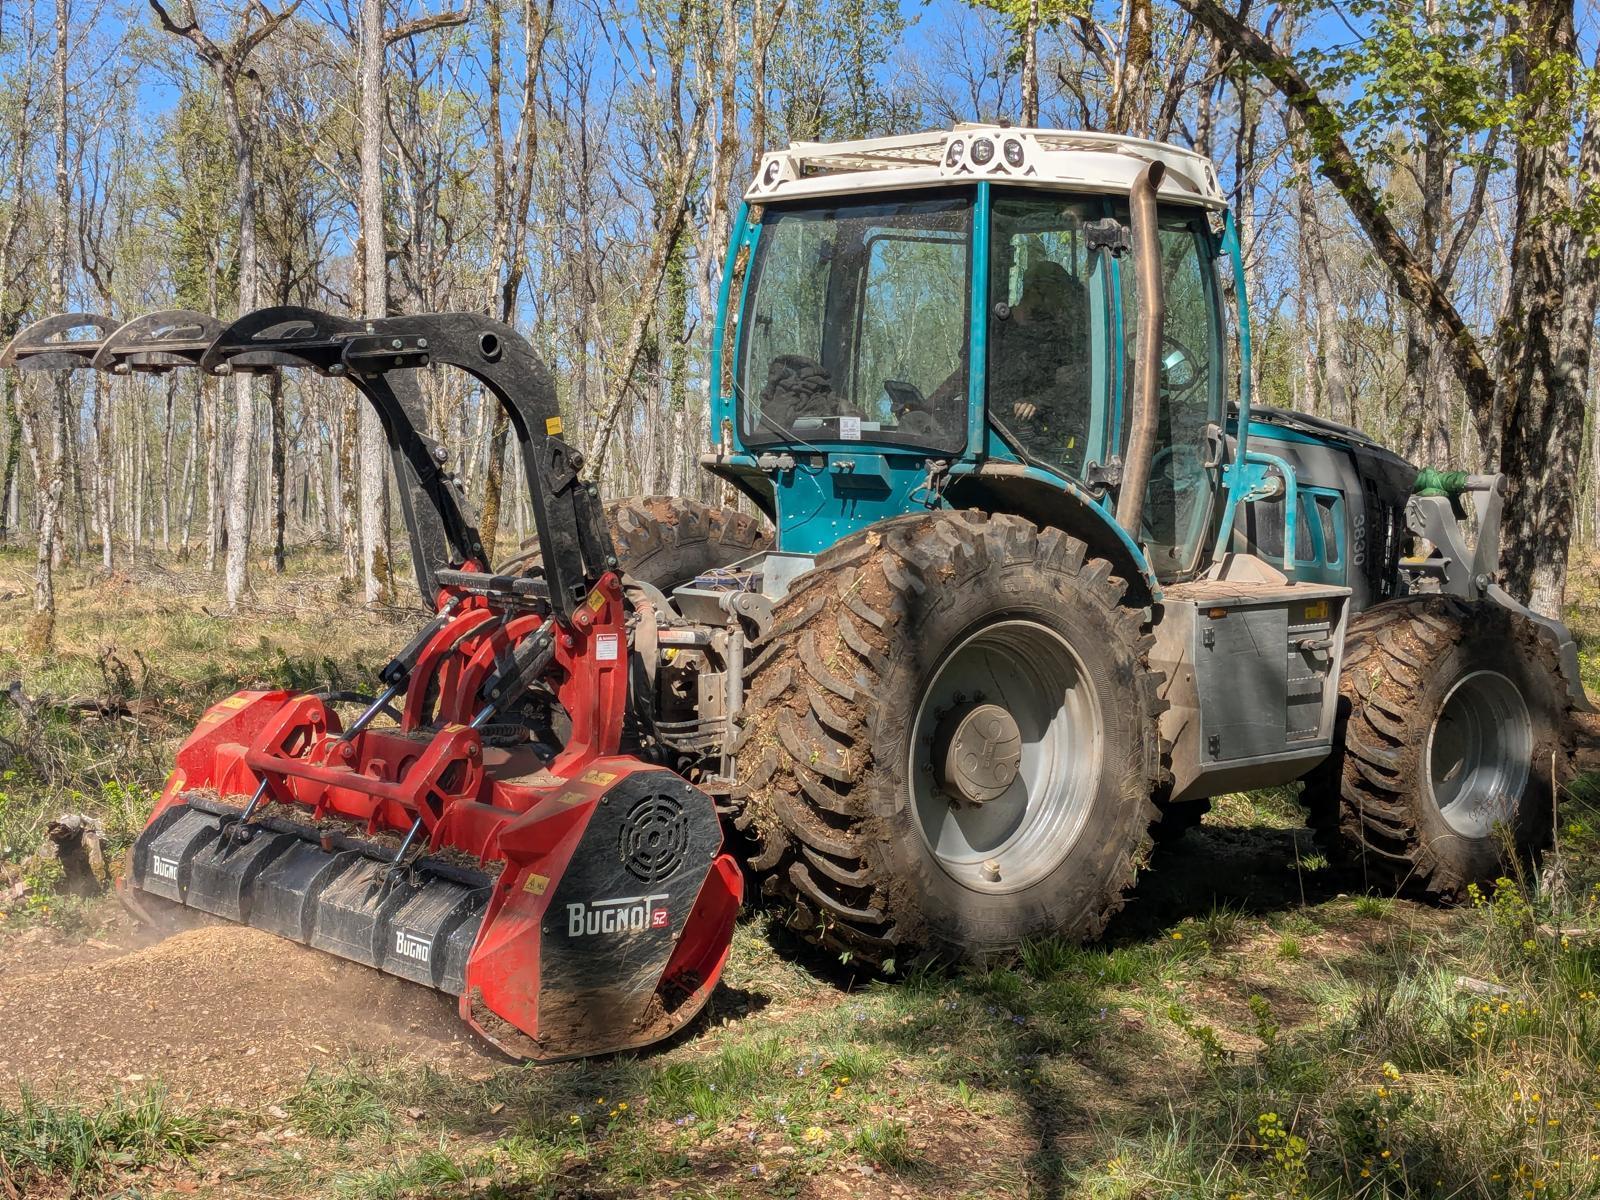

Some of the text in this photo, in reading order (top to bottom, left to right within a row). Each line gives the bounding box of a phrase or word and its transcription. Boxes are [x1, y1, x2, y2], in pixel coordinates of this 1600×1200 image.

[1353, 513, 1366, 566] 3830
[153, 854, 179, 881] BUGNO
[566, 893, 670, 937] BUGNOT
[395, 930, 431, 962] BUGNO
